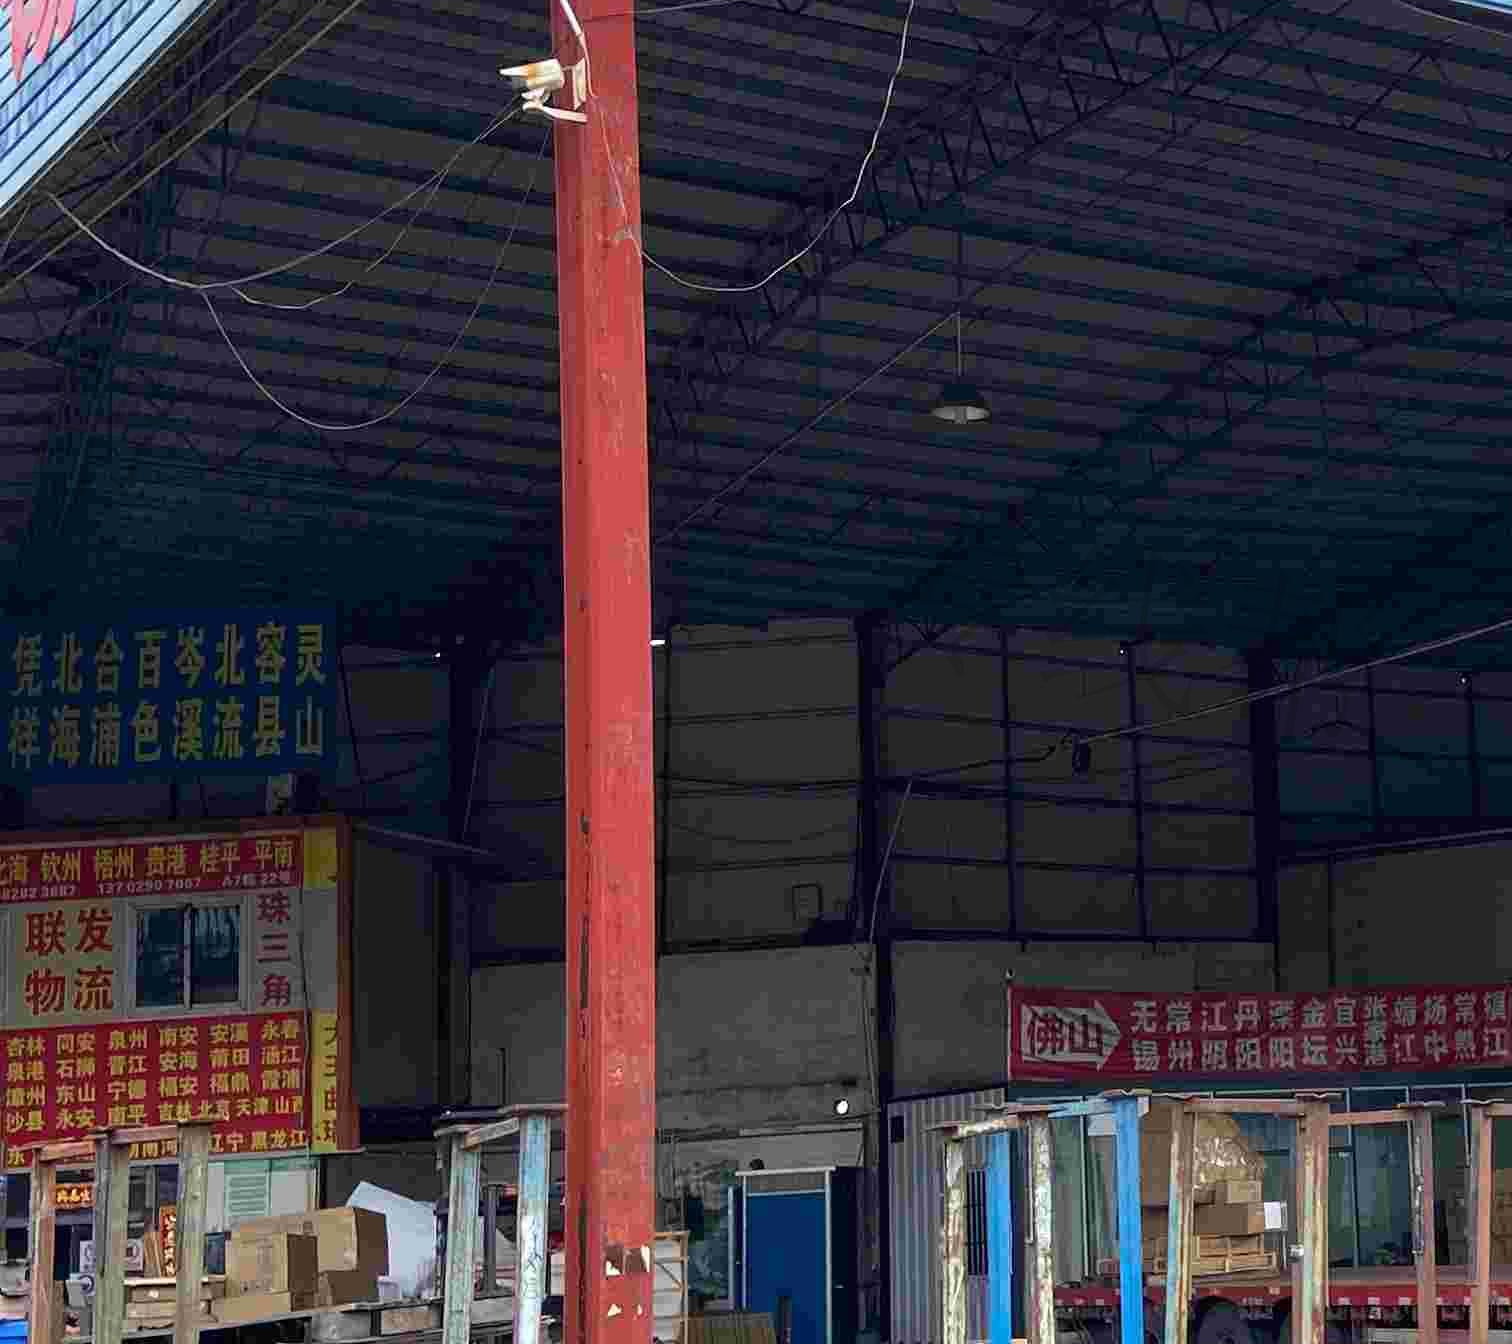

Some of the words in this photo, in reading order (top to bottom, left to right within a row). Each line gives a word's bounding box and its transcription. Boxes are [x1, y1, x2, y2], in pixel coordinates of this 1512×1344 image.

[25, 908, 113, 956] 联发
[257, 891, 290, 1007] 珠三角
[25, 965, 113, 1016] 物流
